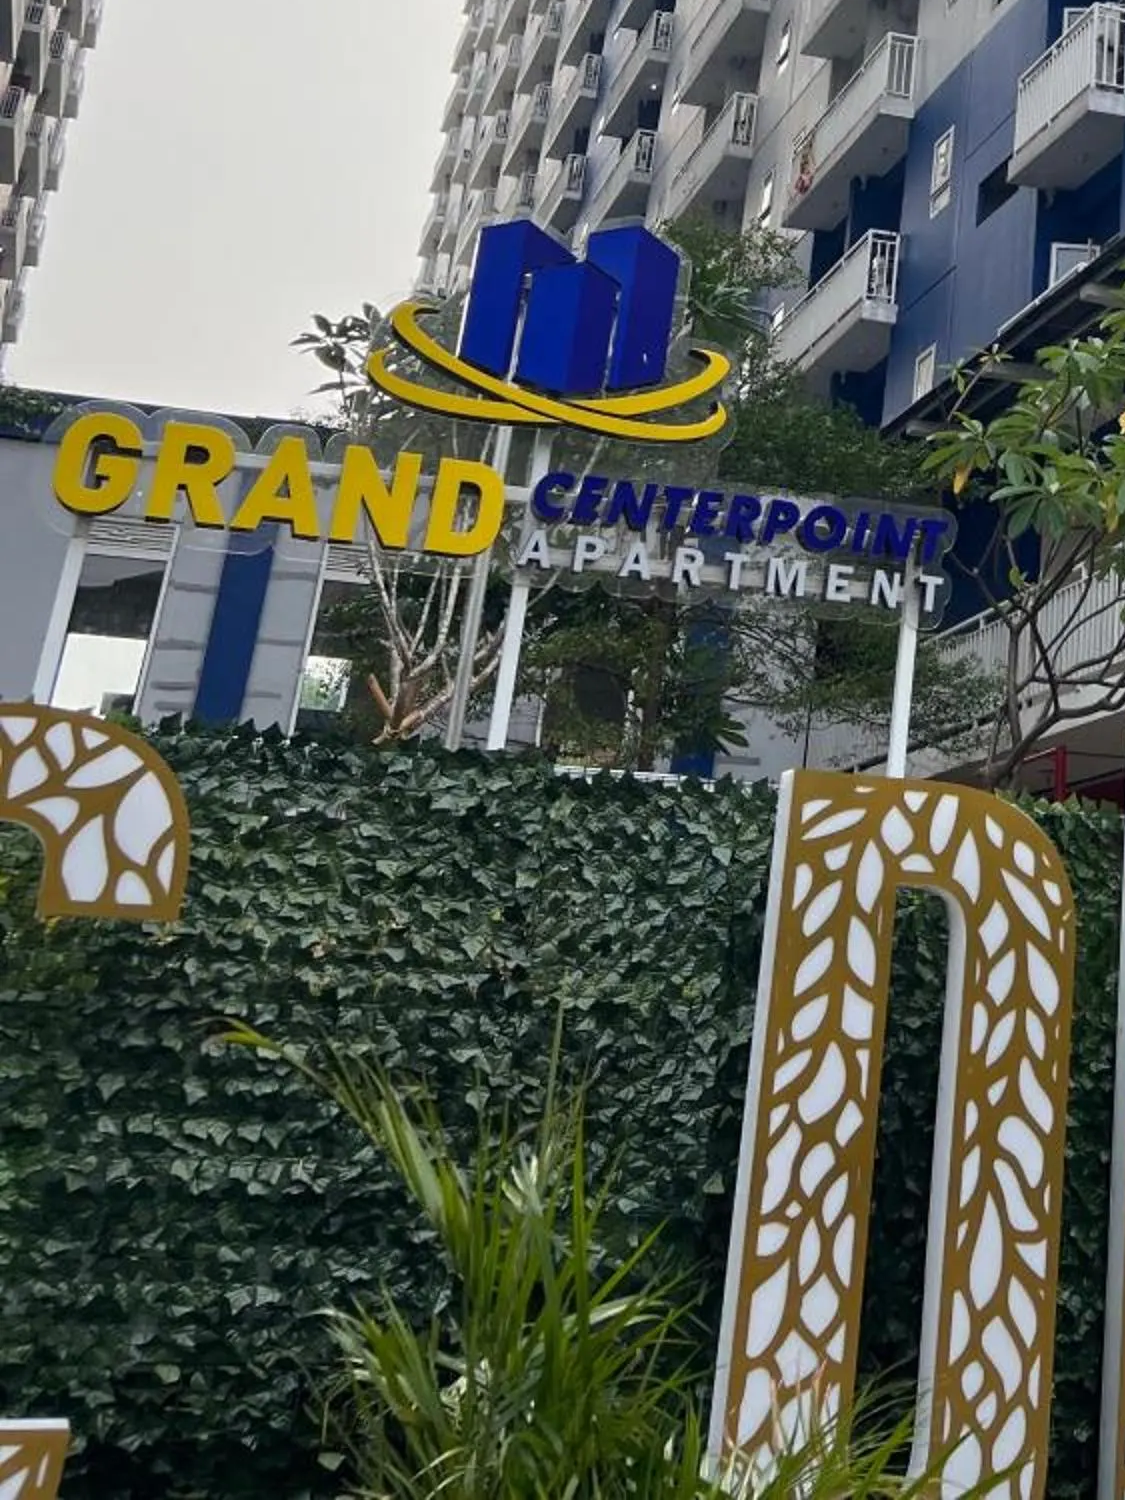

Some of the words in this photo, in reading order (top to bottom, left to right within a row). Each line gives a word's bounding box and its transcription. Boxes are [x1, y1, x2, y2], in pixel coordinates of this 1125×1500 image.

[52, 411, 505, 557] GRAND
[532, 471, 951, 566] CENTERPOINT
[518, 528, 945, 613] APARTMENT
